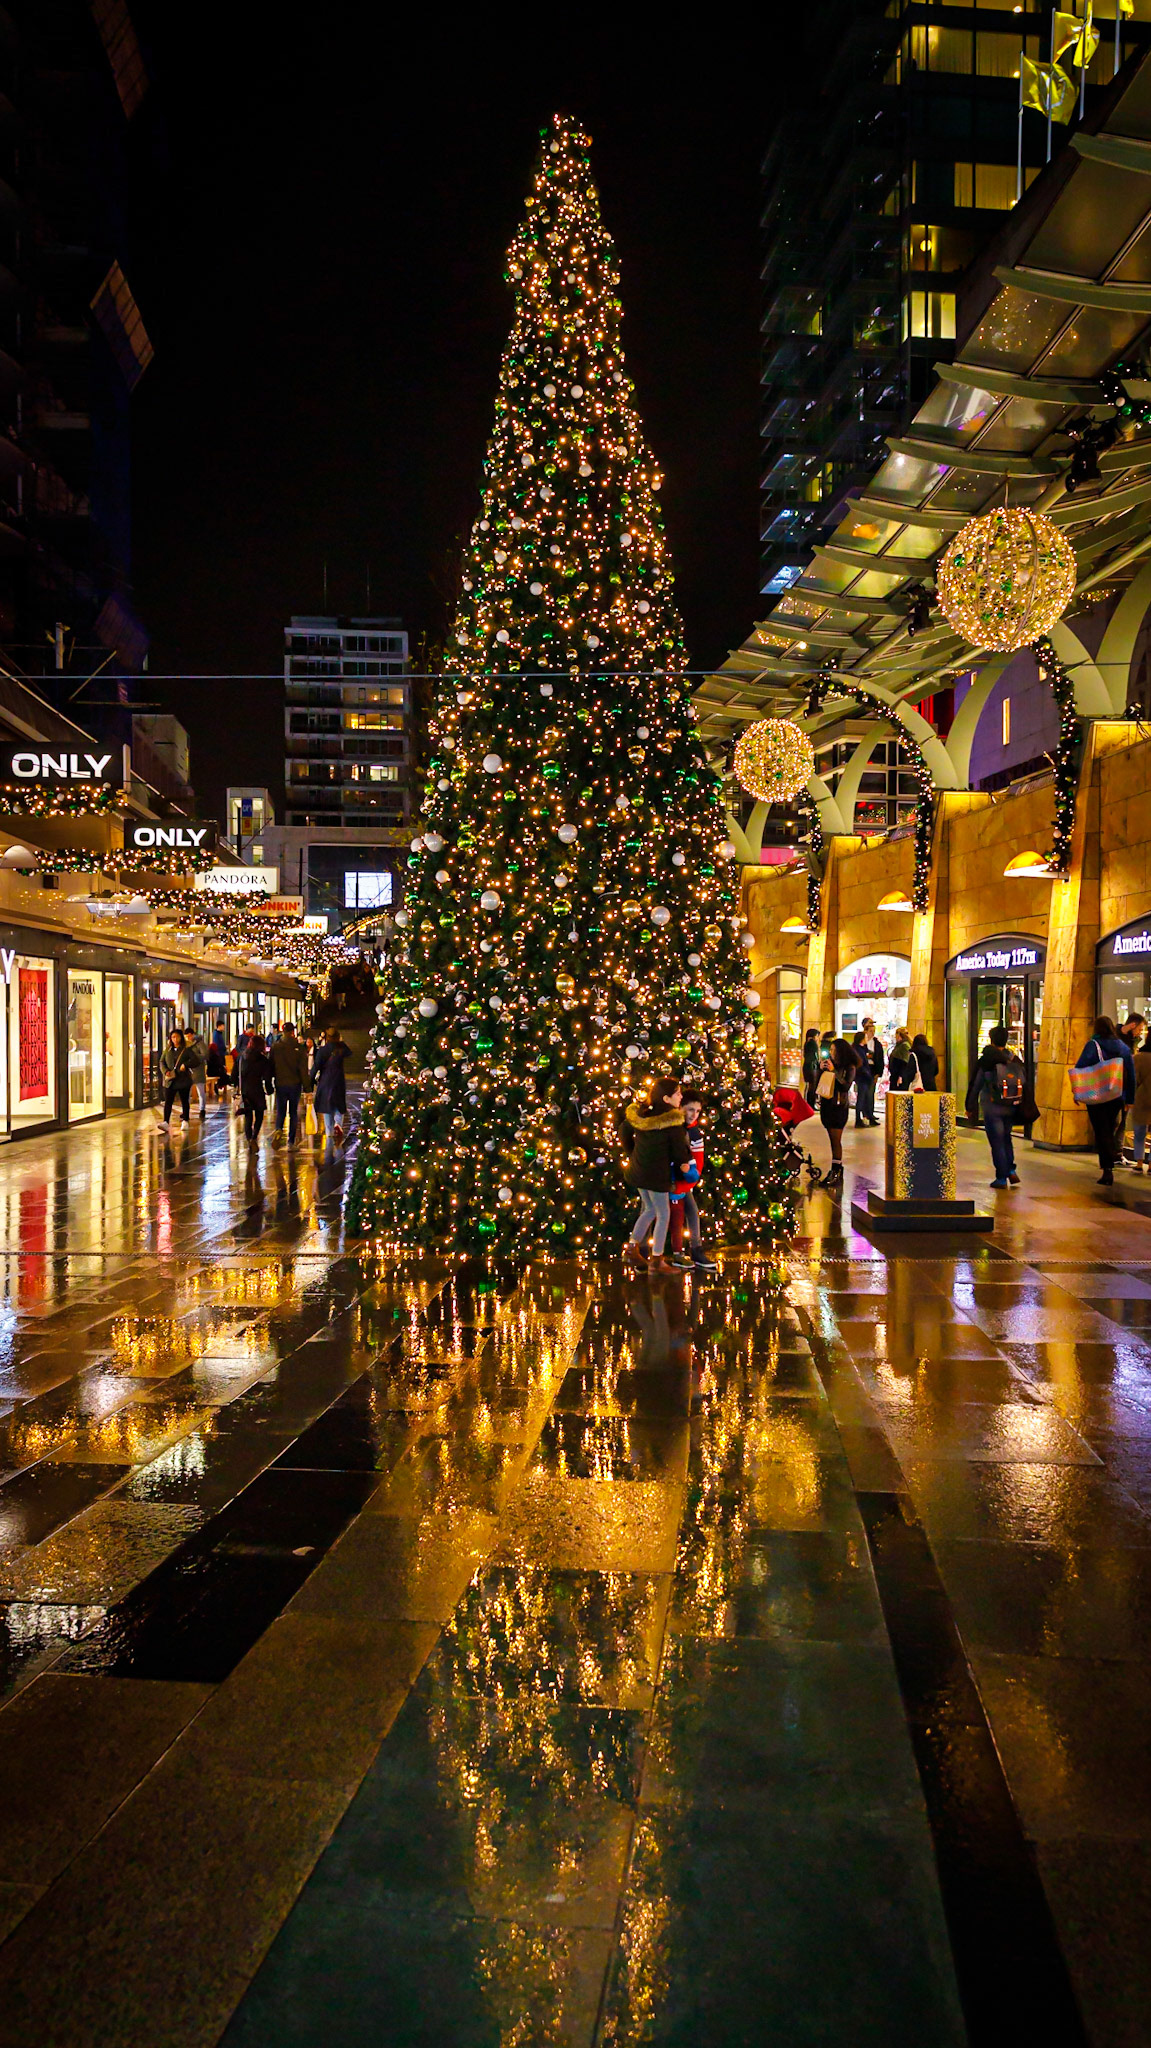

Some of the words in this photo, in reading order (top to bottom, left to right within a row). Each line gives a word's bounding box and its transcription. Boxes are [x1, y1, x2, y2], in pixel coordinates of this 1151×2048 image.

[11, 753, 112, 778] ONLY
[134, 827, 207, 846] ONLY
[204, 872, 268, 885] PANDORA
[955, 954, 986, 971] America
[986, 950, 1011, 970] Today
[850, 967, 889, 993] claire's
